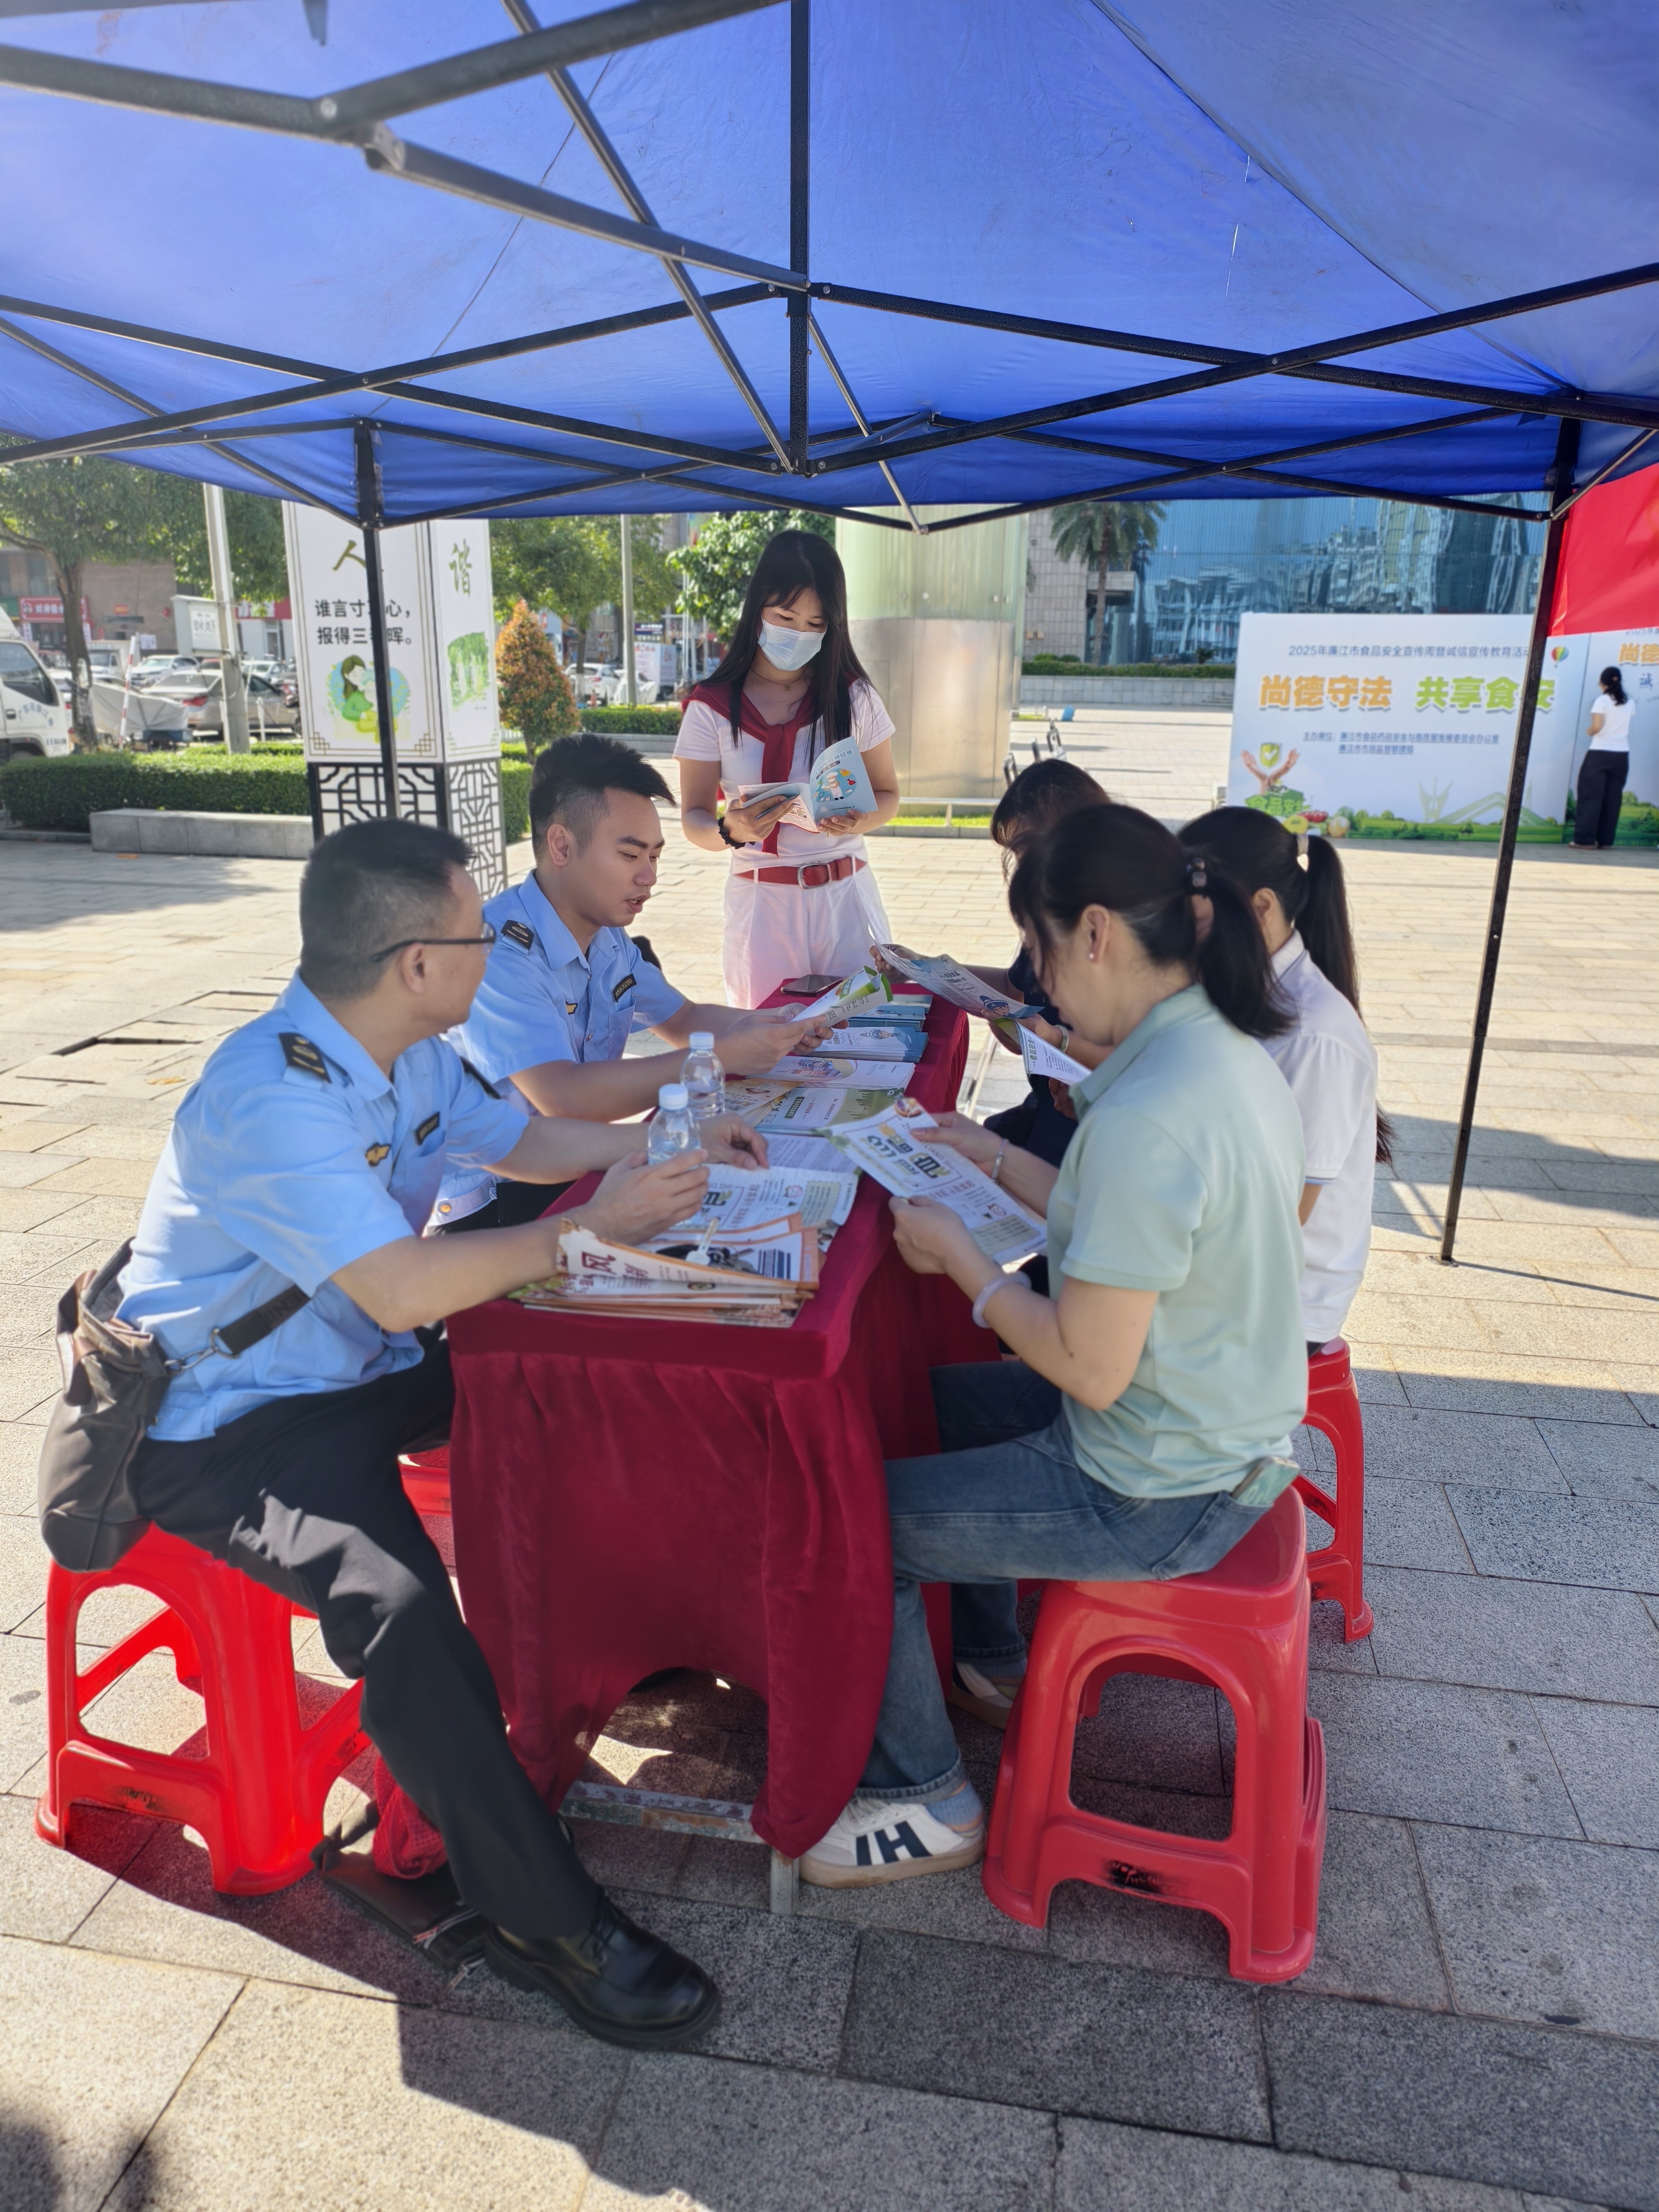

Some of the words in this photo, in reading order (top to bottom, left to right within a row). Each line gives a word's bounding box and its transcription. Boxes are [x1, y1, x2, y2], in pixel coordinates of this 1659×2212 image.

[315, 599, 410, 618] 谁言寸心，
[317, 626, 412, 645] 报得三晖。
[1259, 674, 1392, 708] 尚德守法
